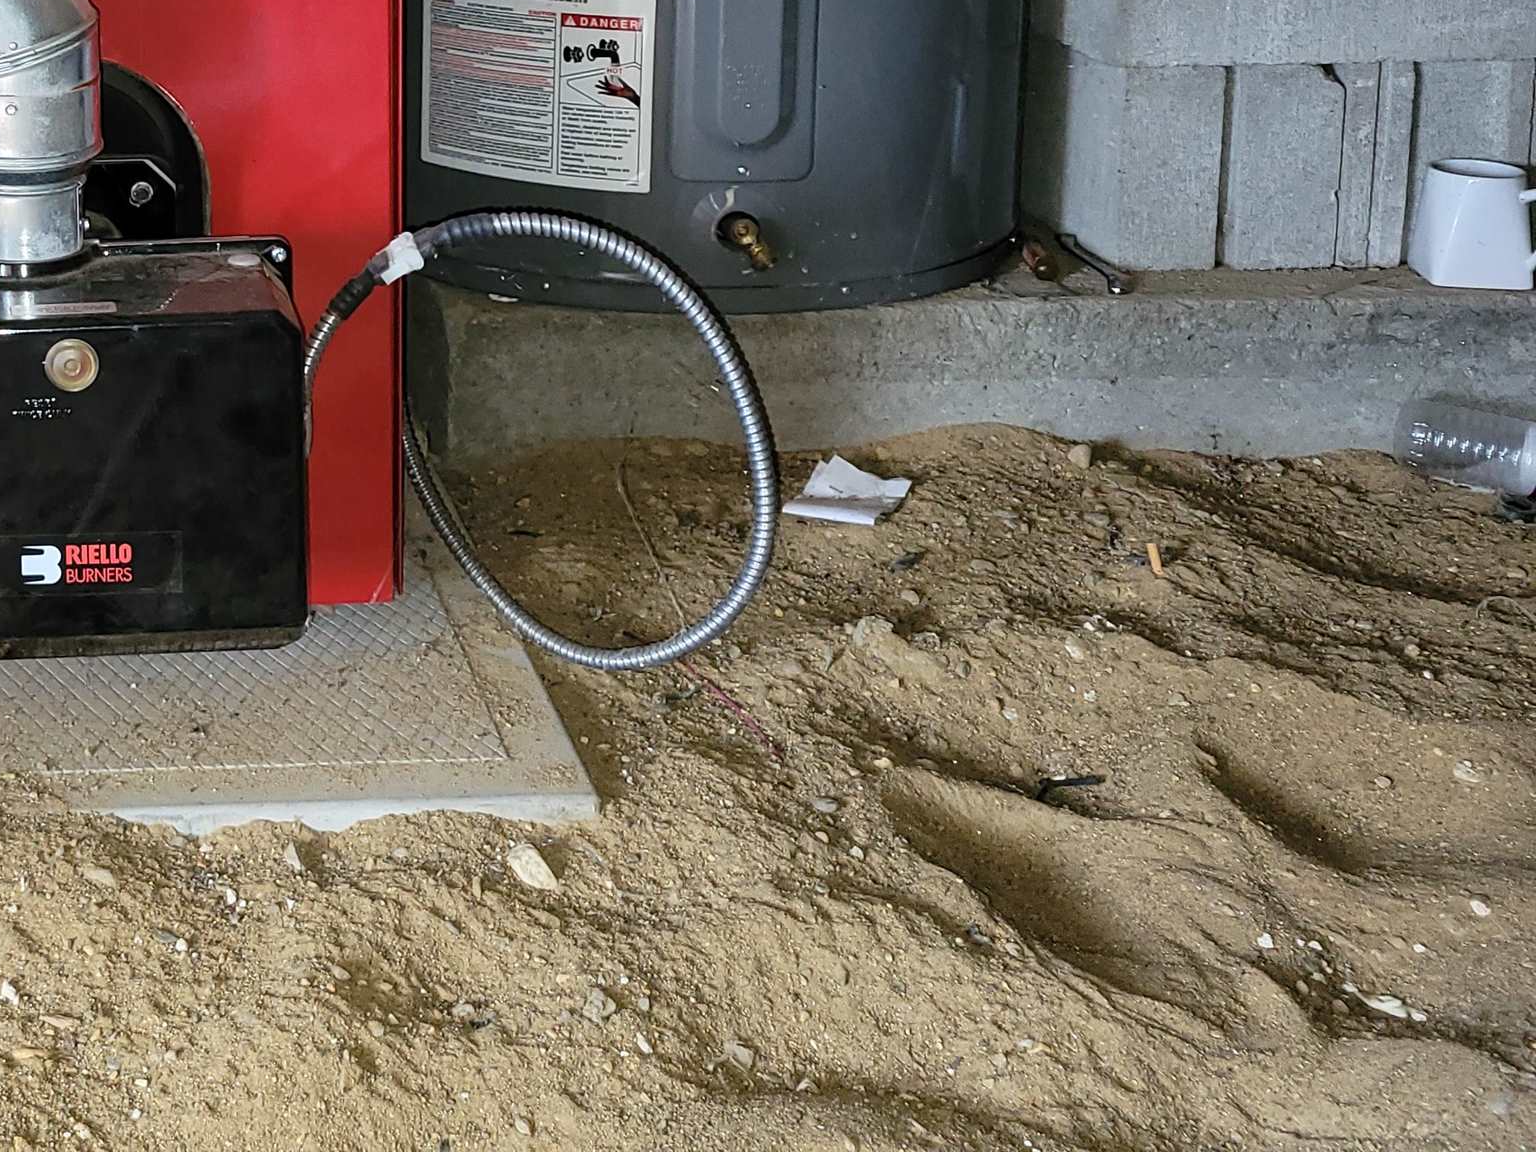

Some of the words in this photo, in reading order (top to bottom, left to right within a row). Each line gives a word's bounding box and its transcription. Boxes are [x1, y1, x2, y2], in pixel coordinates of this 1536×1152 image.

[579, 16, 640, 30] DANGER
[606, 67, 623, 75] HOT
[65, 544, 132, 565] RIELLO
[66, 567, 133, 584] BURNERS
